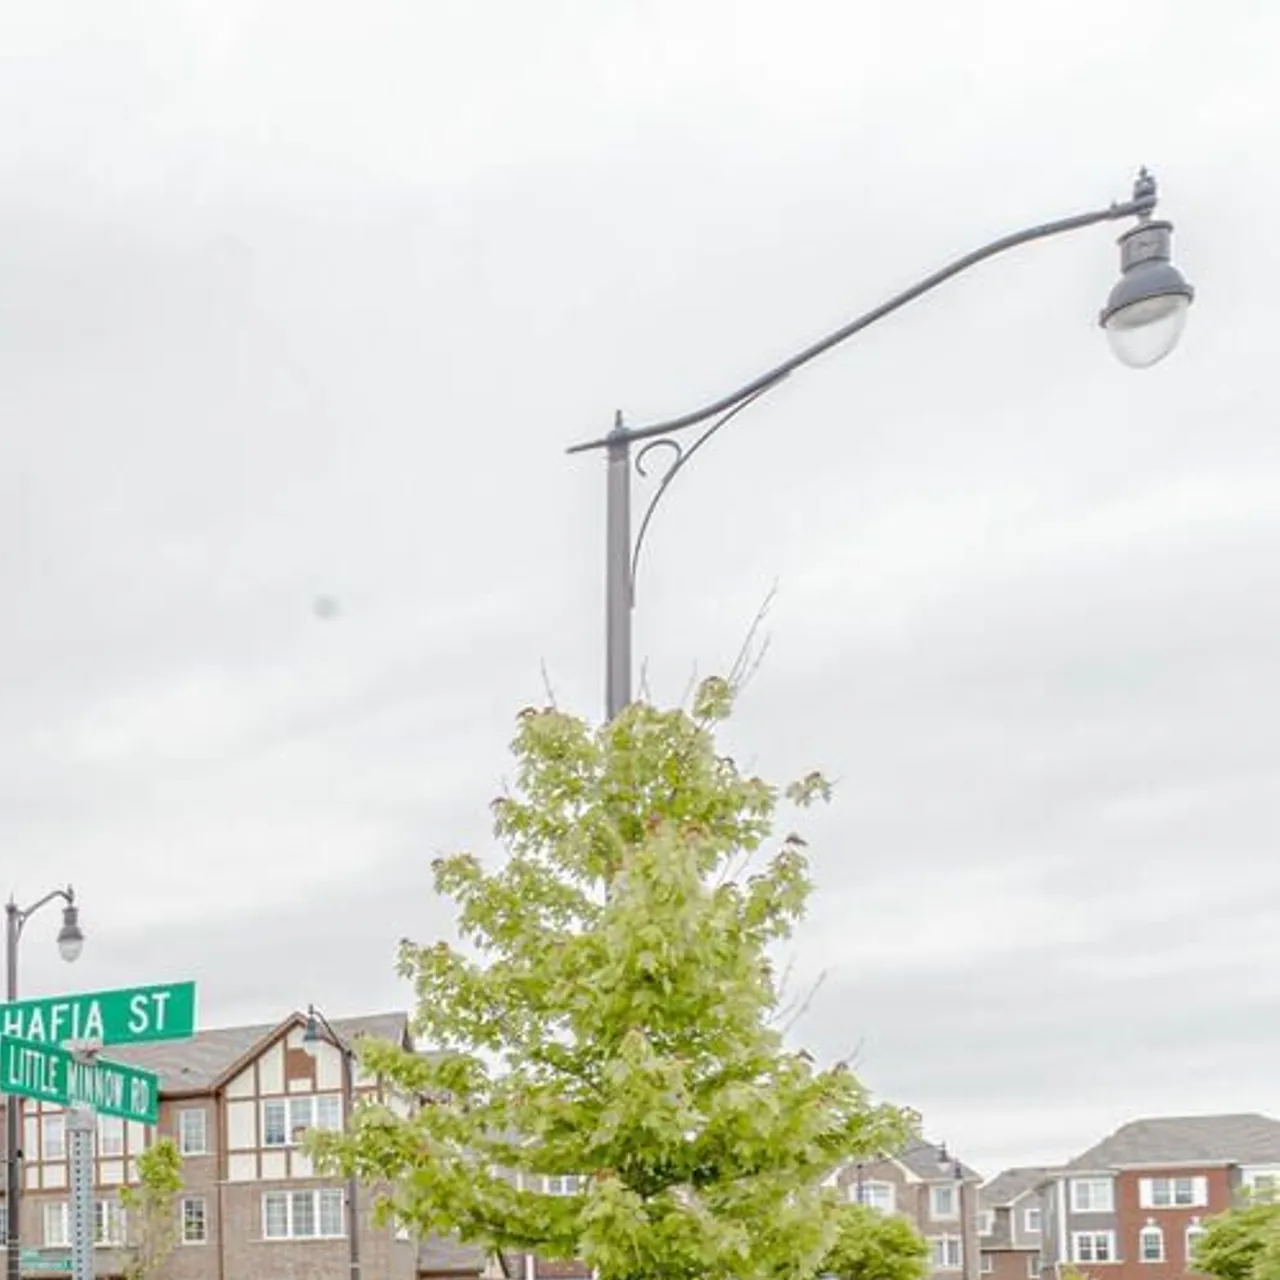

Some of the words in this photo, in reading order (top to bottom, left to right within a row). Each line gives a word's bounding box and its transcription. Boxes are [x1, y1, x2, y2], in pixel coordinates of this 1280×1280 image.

[4, 1000, 104, 1043] HAFIA
[128, 991, 171, 1033] ST
[9, 1045, 60, 1094] LITTLE
[67, 1060, 124, 1108] MINNOW
[130, 1076, 150, 1114] RD
